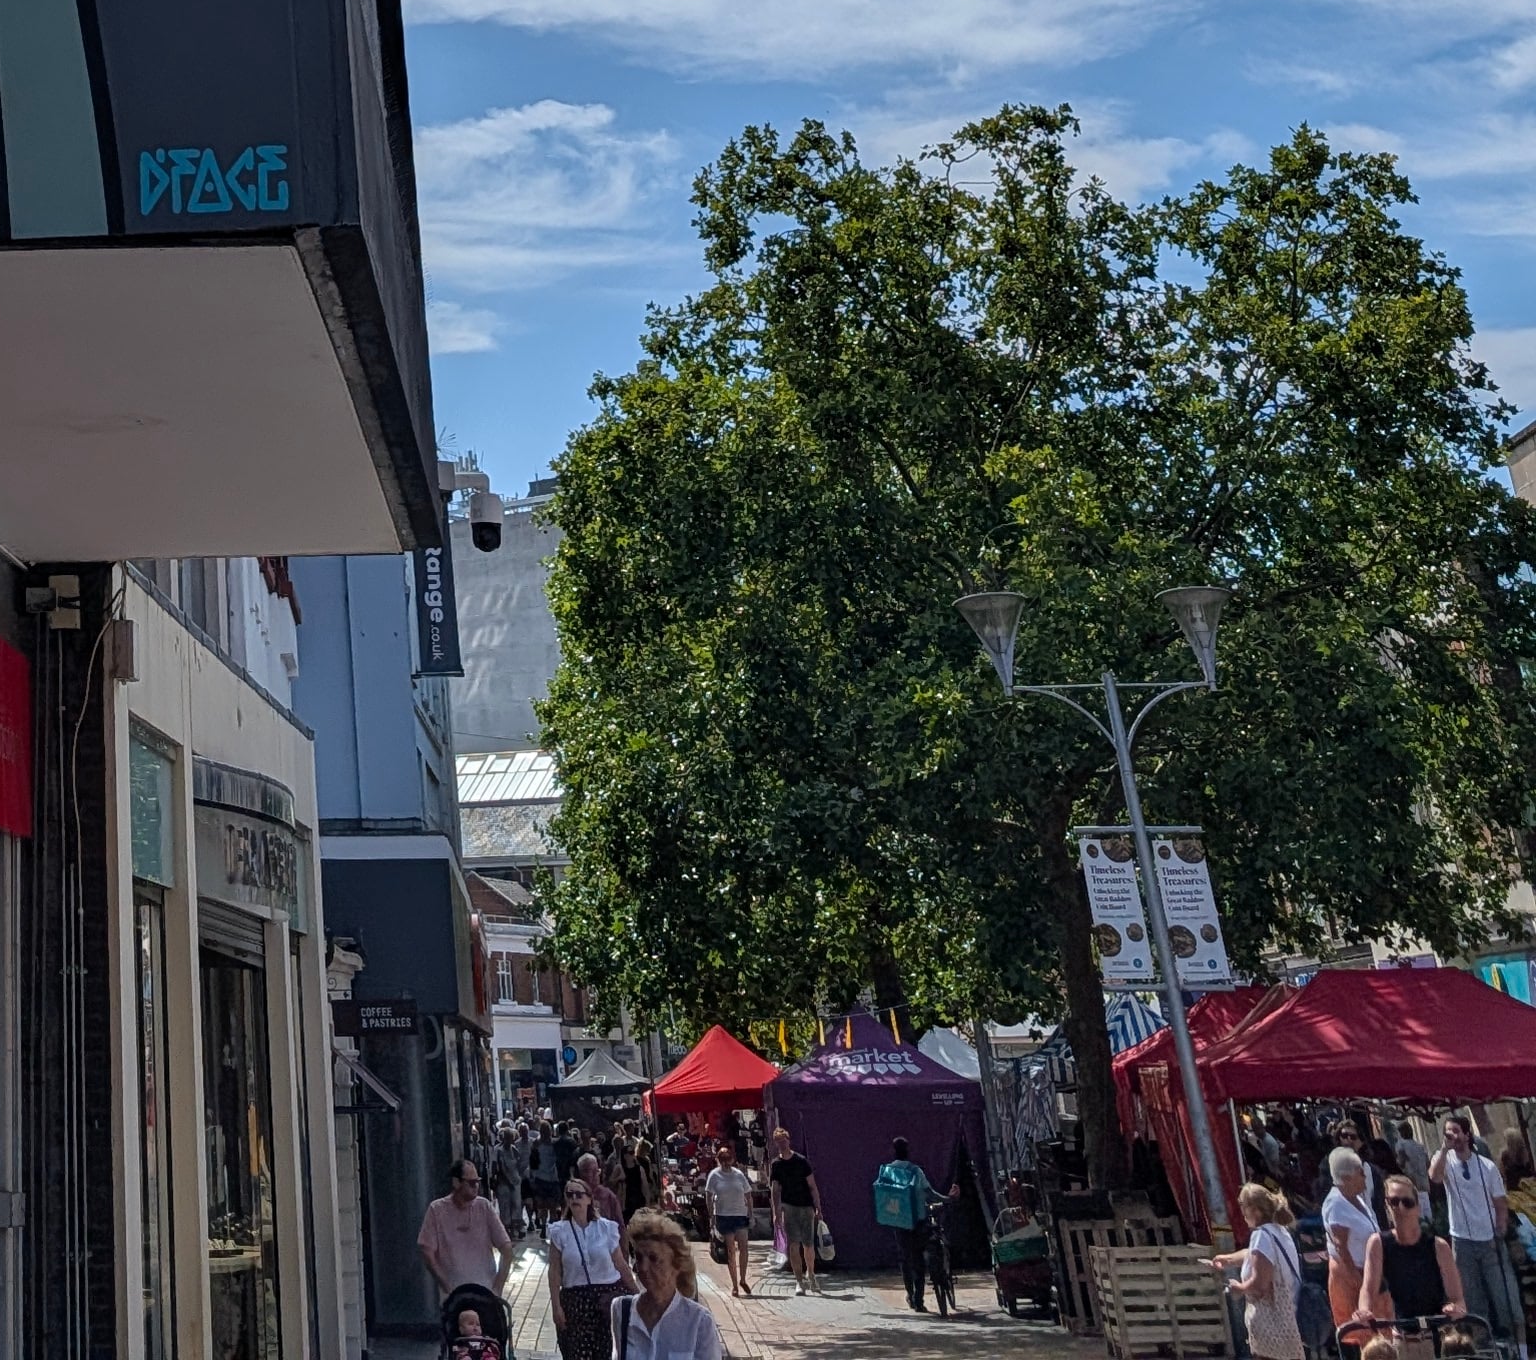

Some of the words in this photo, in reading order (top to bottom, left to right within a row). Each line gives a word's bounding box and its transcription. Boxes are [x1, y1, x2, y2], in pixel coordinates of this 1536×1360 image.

[1089, 865, 1126, 875] Timeless
[1161, 866, 1199, 876] Timeless
[1091, 876, 1135, 885] Treasures:
[1164, 877, 1207, 886] Treasures:
[360, 1007, 392, 1017] COFFEE
[362, 1019, 368, 1028] &
[369, 1018, 412, 1028] PASTRIES
[829, 1048, 914, 1067] market
